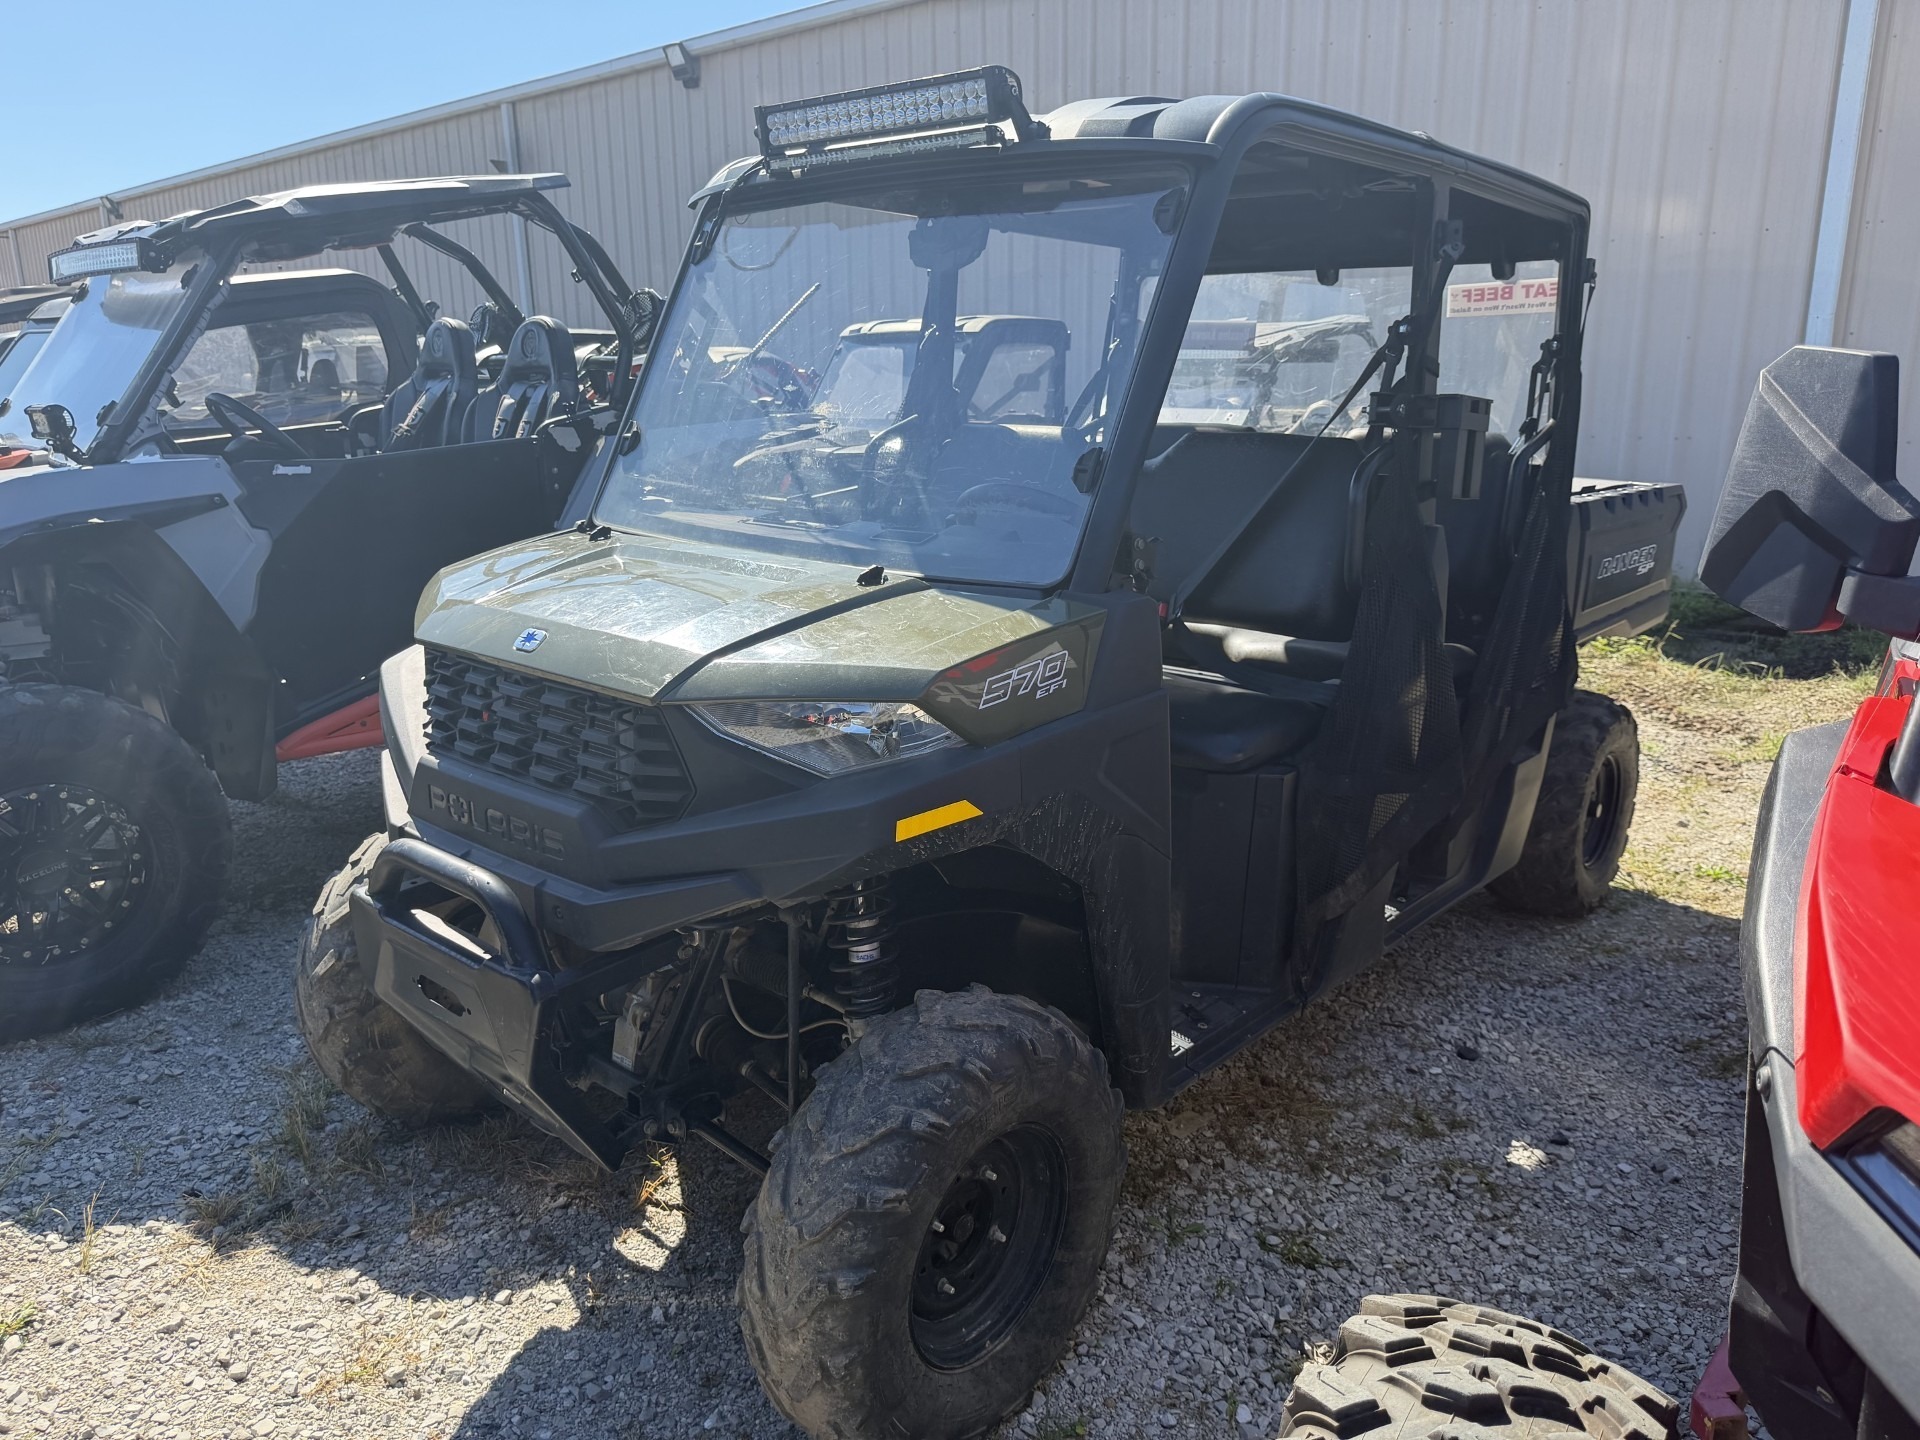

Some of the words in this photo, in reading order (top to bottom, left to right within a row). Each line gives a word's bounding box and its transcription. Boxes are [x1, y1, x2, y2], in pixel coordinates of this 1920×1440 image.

[1597, 544, 1657, 579] RANGER
[1636, 562, 1655, 575] SP
[978, 650, 1068, 710] 570
[1035, 679, 1067, 699] EFI
[427, 784, 566, 861] POLARIS
[18, 862, 68, 884] RACELINE
